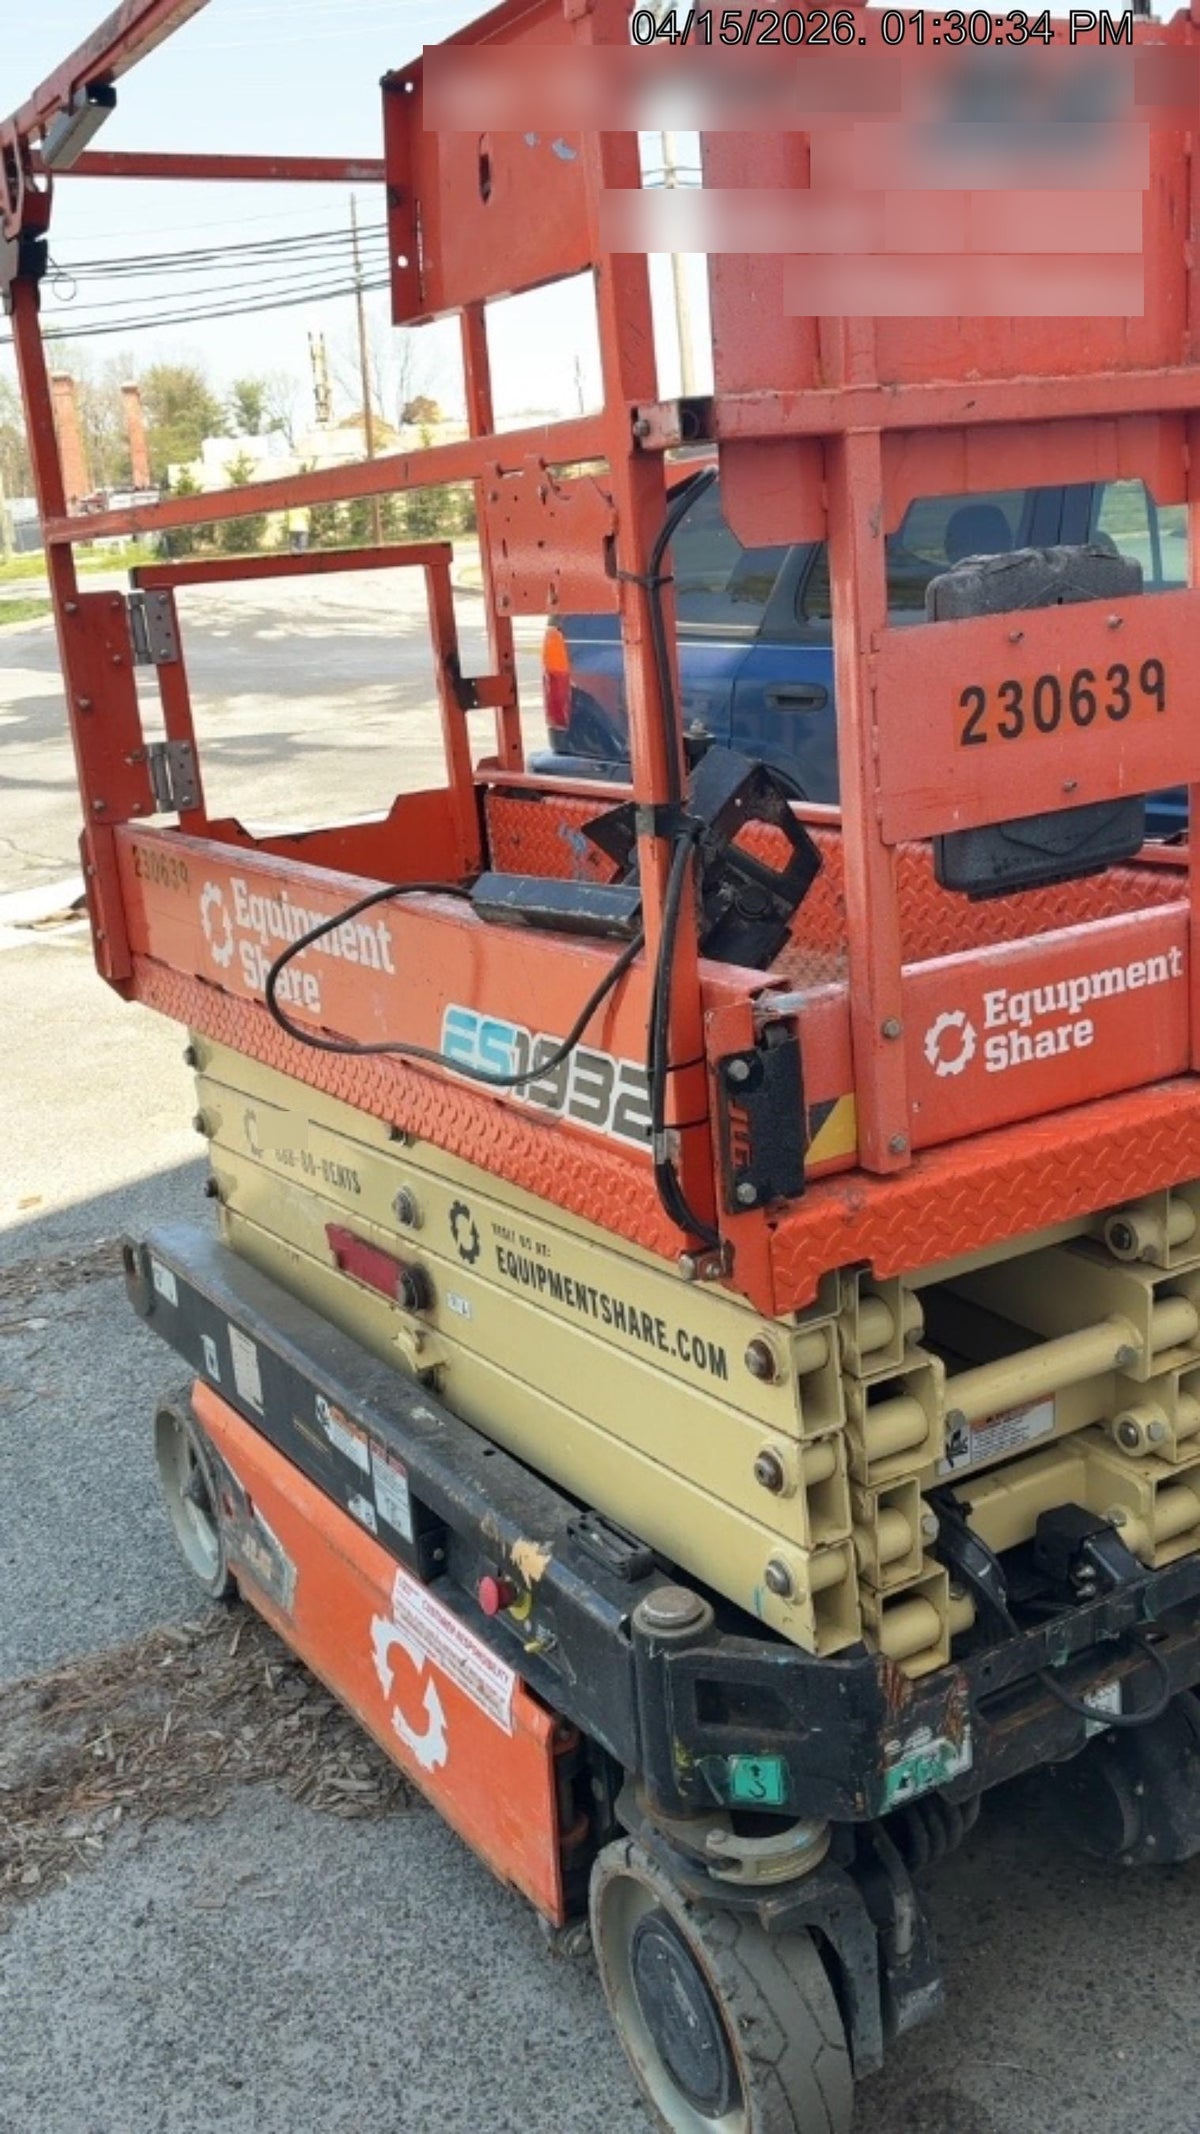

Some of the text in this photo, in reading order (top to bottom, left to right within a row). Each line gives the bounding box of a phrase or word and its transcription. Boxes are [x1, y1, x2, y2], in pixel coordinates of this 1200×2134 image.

[959, 658, 1166, 747] 230639
[230, 877, 395, 974] Equipment
[239, 939, 321, 1013] Share
[983, 945, 1184, 1030] Equipment
[441, 1003, 655, 1154] ES1932
[984, 1018, 1095, 1073] Share
[495, 1245, 729, 1381] EQUIPMENTSHARE.COM
